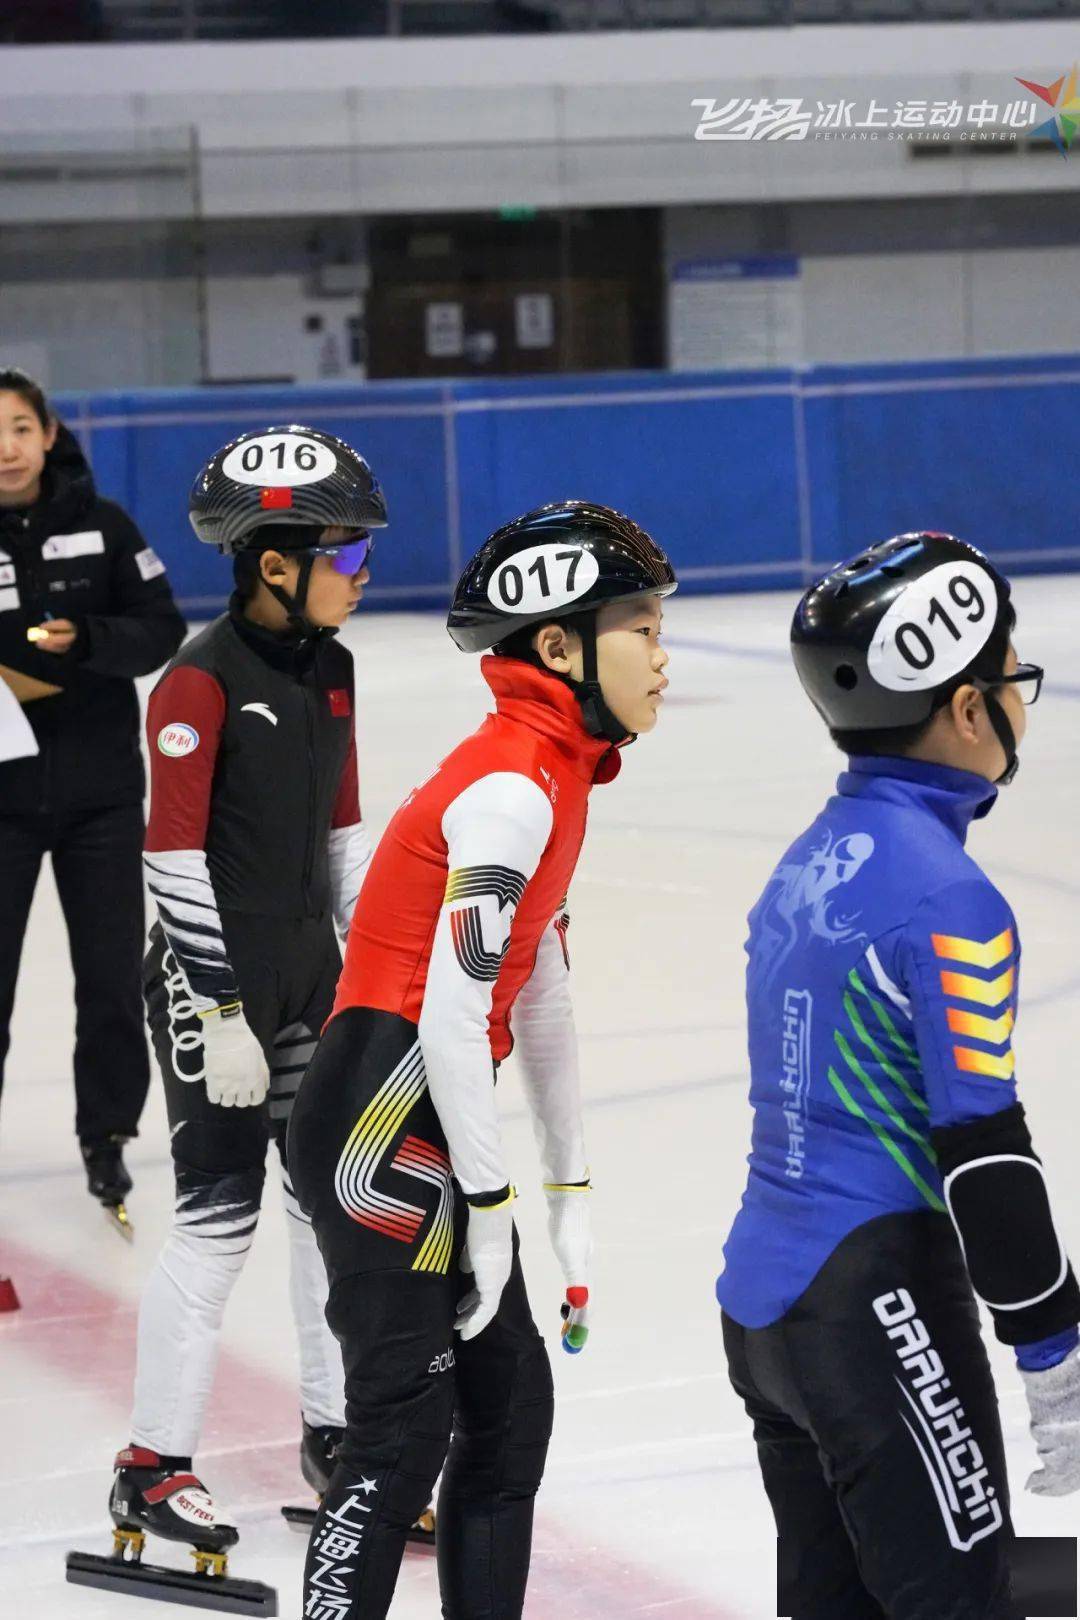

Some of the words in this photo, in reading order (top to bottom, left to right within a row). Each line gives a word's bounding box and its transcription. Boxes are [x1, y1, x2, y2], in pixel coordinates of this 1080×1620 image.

[241, 442, 317, 472] 016
[498, 549, 584, 607] 017
[894, 575, 985, 671] 019
[163, 732, 192, 748] 伊利
[176, 1495, 195, 1515] BEST
